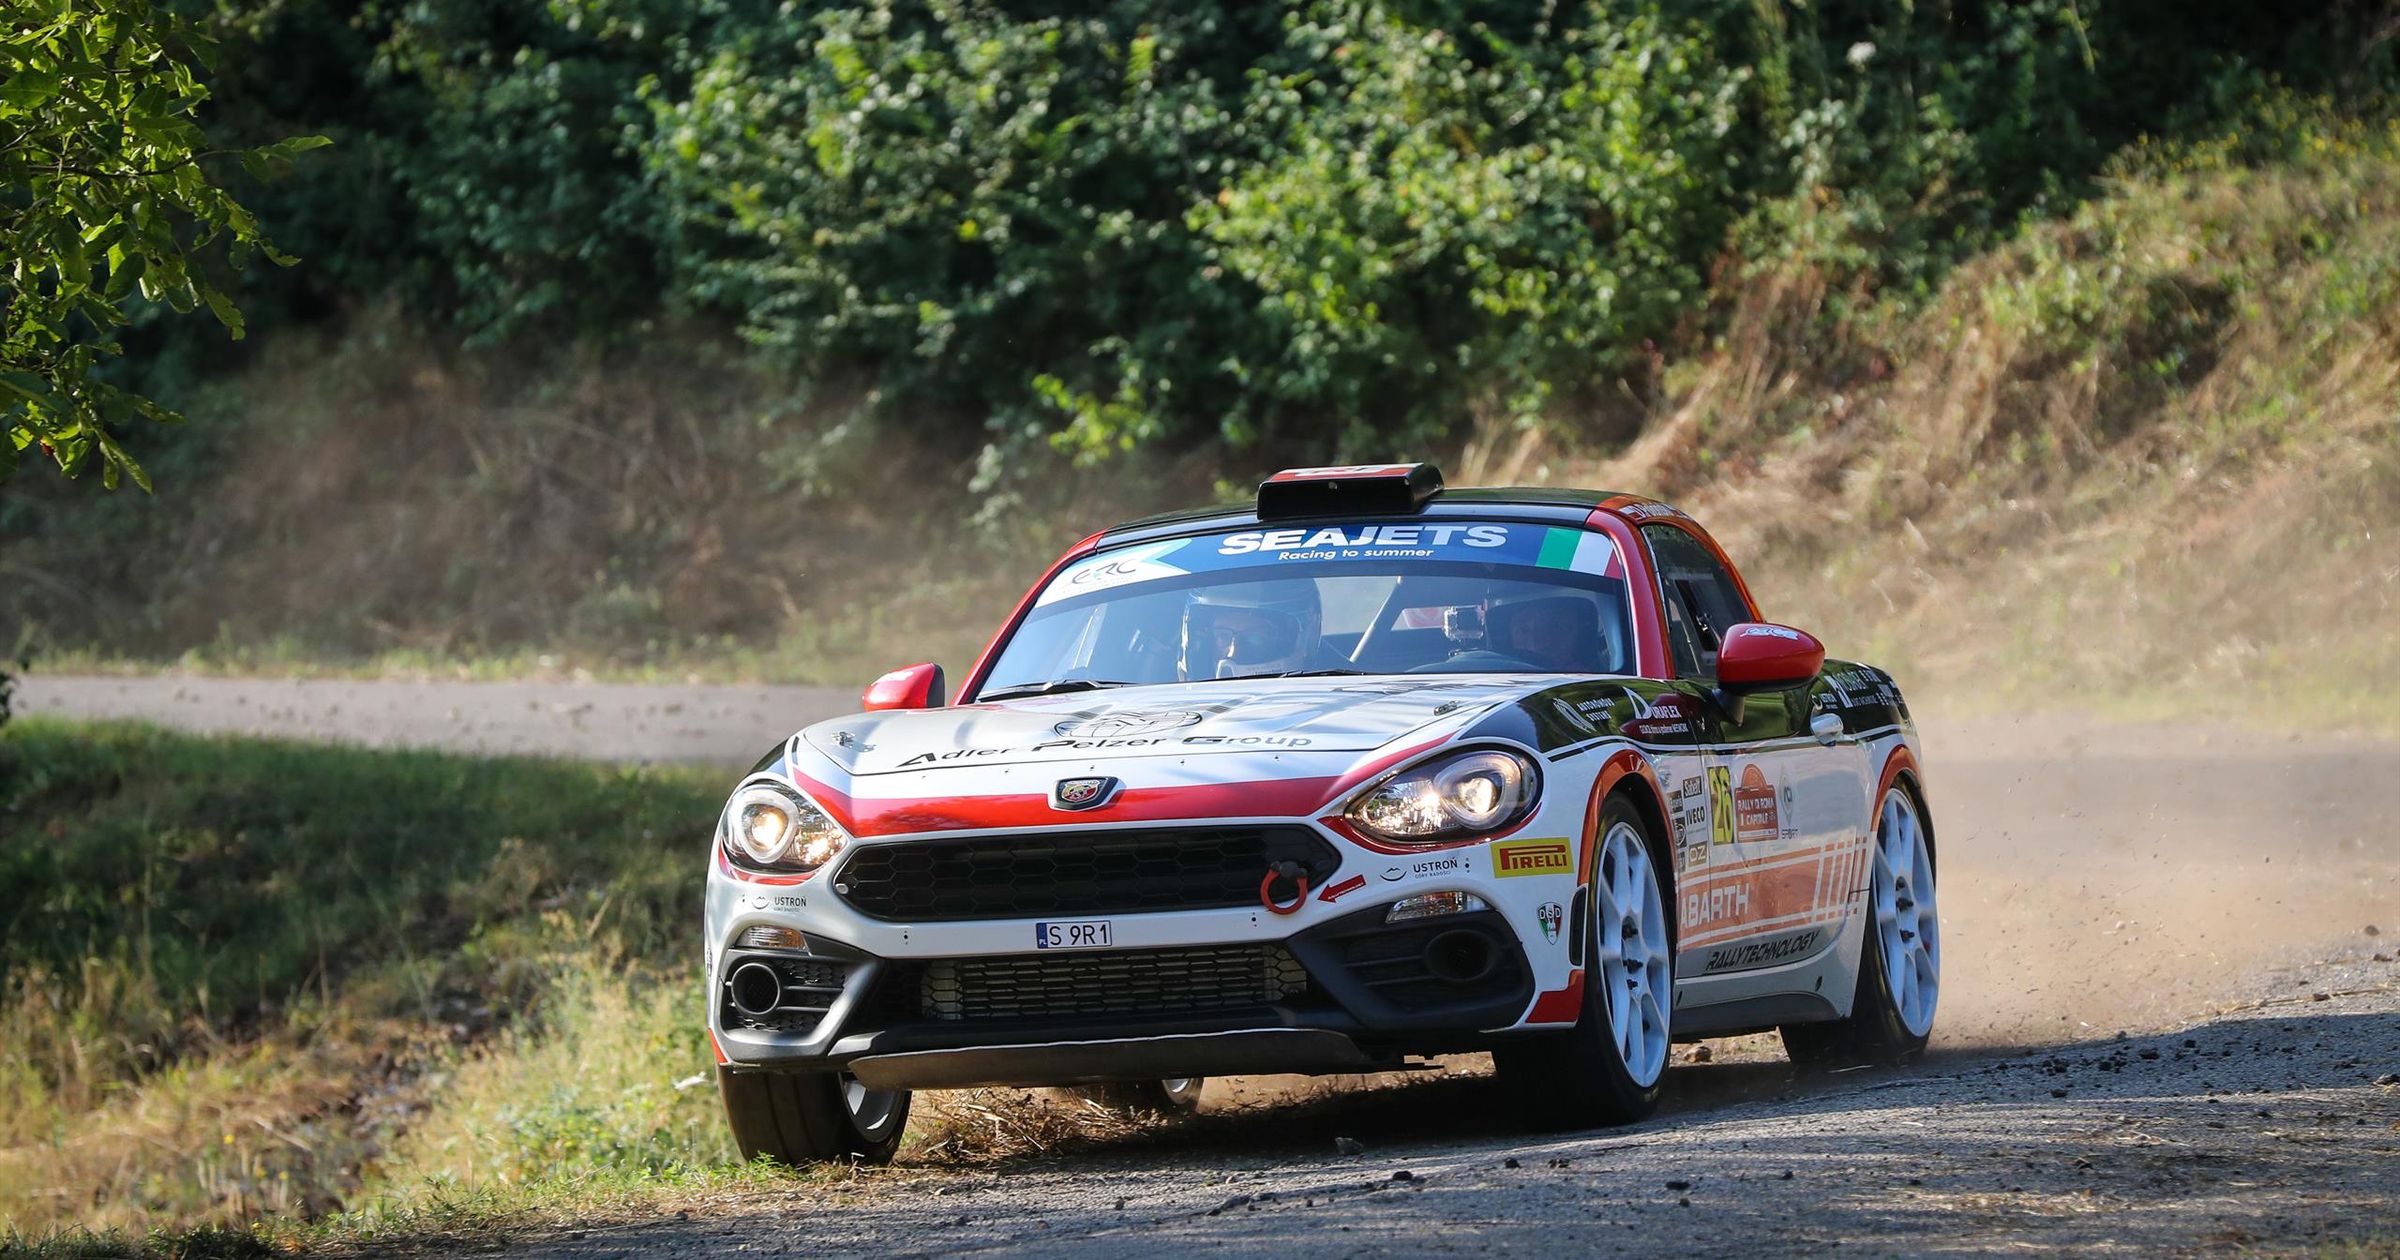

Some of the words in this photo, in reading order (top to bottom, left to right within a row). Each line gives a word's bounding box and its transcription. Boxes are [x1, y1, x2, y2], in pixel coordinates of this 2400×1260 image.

[1218, 525, 1509, 556] SEAJETS
[1278, 549, 1336, 561] Racing
[1342, 549, 1358, 558] to
[1364, 549, 1434, 558] summer
[897, 746, 1019, 768] Adler
[1031, 736, 1171, 753] Pelzer
[1181, 735, 1313, 748] Group
[1685, 806, 1705, 826] IVECO
[1709, 767, 1734, 843] 26
[1413, 857, 1458, 873] USTROŃ
[1500, 845, 1568, 871] PIRELLI
[1689, 844, 1706, 861] OZ
[1681, 883, 1750, 928] ABARTH
[1049, 925, 1062, 946] S
[1069, 924, 1108, 946] 9R1
[1705, 930, 1820, 971] RALLYTECHNOLOGY
